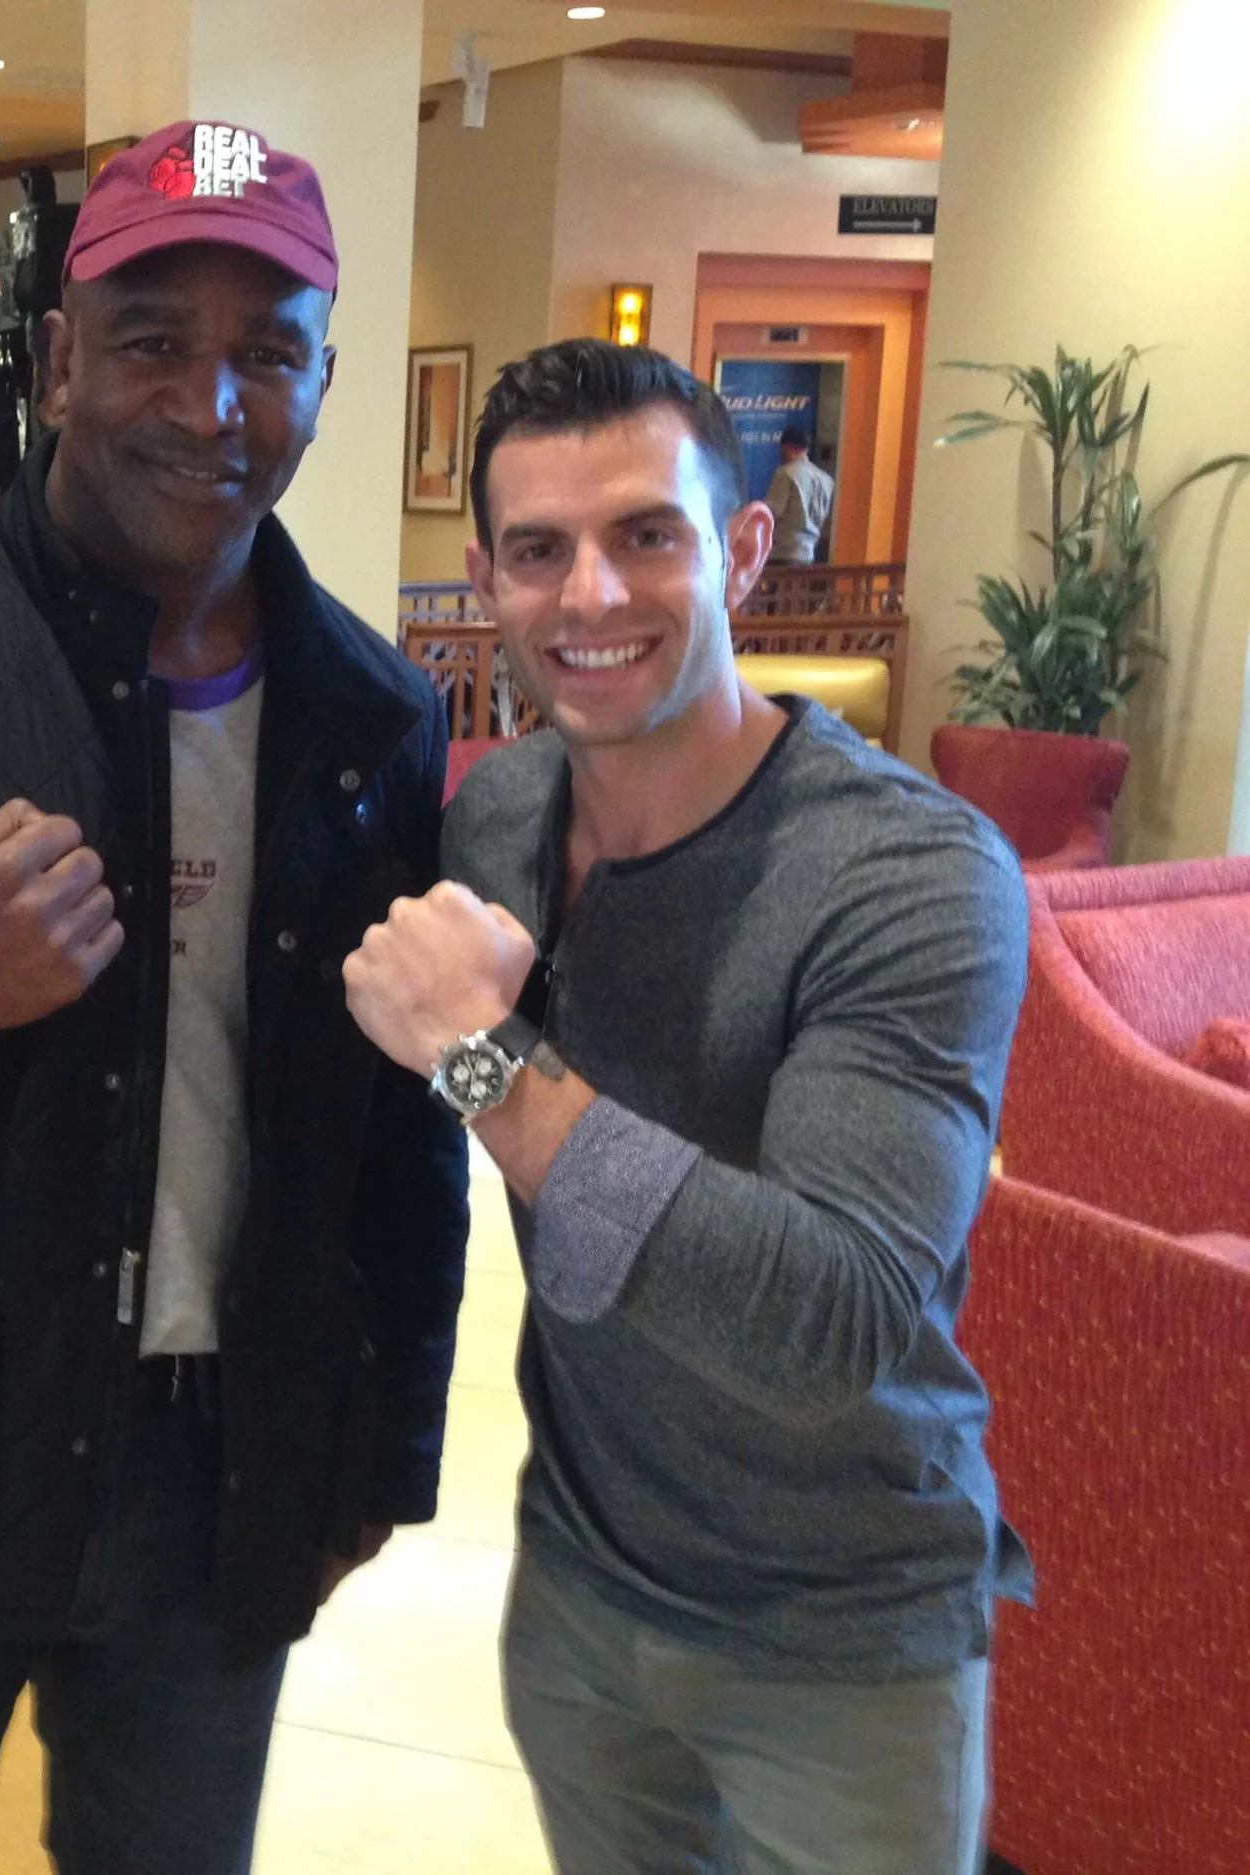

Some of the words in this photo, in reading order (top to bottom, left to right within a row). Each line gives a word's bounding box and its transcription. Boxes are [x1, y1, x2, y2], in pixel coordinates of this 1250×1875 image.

[194, 124, 267, 161] REAL
[193, 152, 267, 184] DEAL
[722, 395, 752, 412] UD
[753, 394, 811, 411] LIGHT
